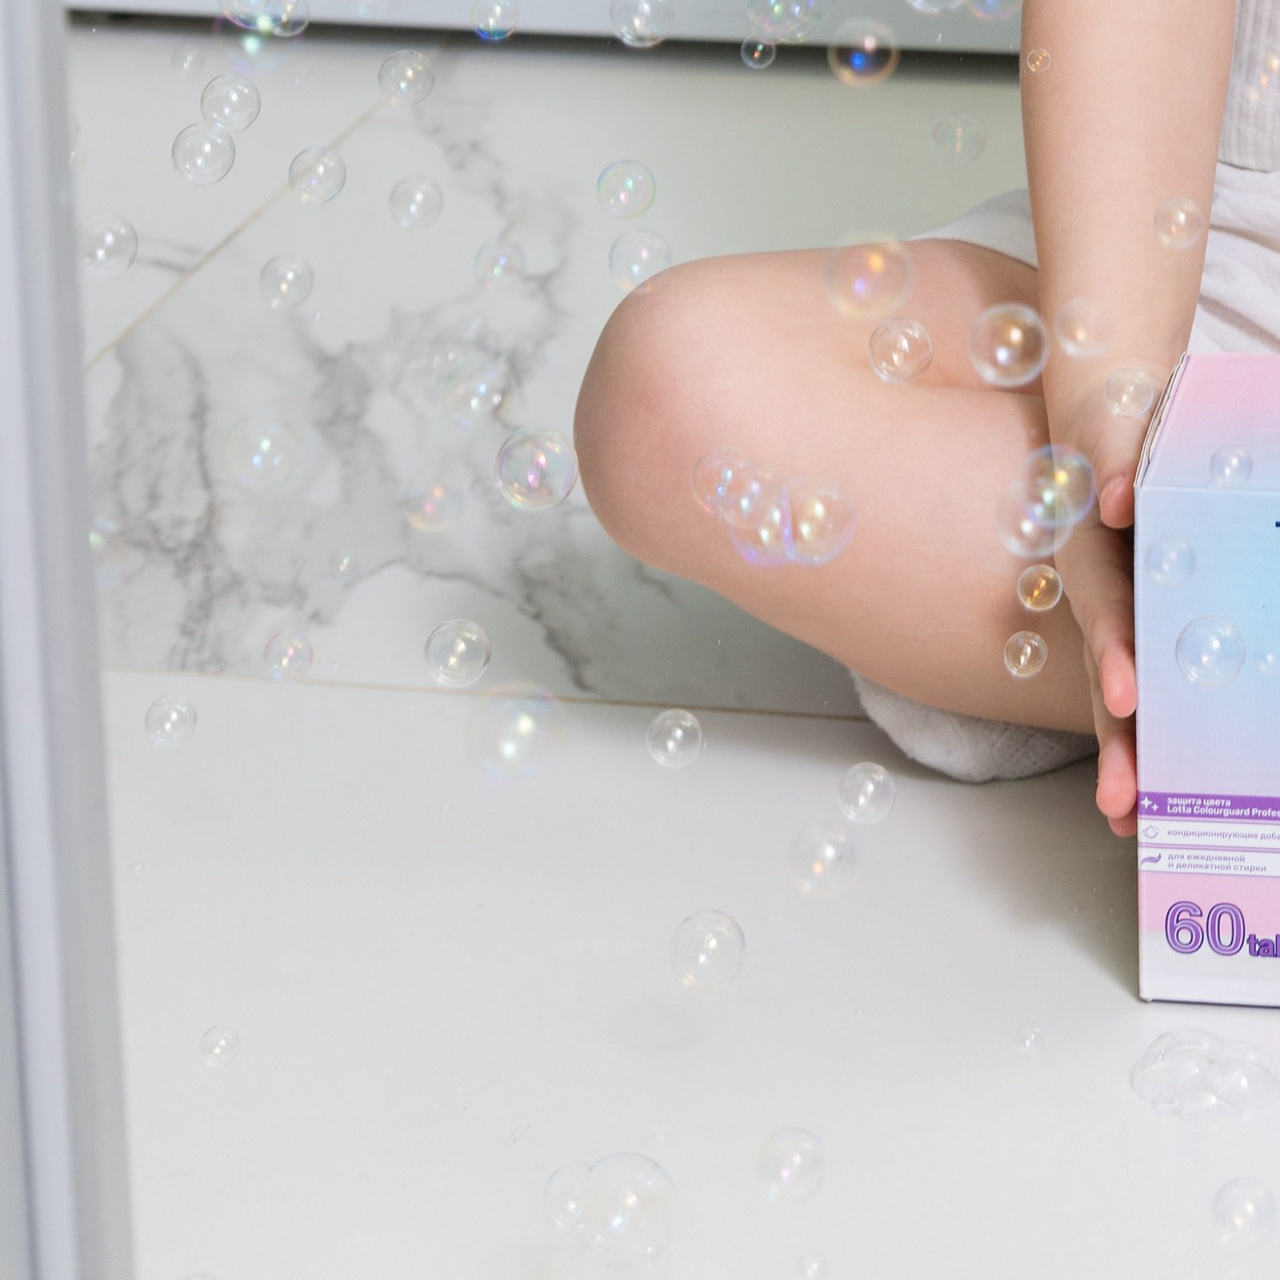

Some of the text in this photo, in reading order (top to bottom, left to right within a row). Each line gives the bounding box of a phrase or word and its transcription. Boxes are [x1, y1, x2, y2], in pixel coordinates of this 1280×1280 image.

[1166, 797, 1231, 807] защита цвета
[1166, 805, 1192, 814] Lotta
[1193, 806, 1250, 818] Colourguard
[1167, 828, 1259, 840] кондиционирующие
[1167, 853, 1246, 864] для ежедневной
[1175, 862, 1232, 872] деликатной
[1233, 865, 1267, 874] стирки
[1165, 900, 1246, 956] 60
